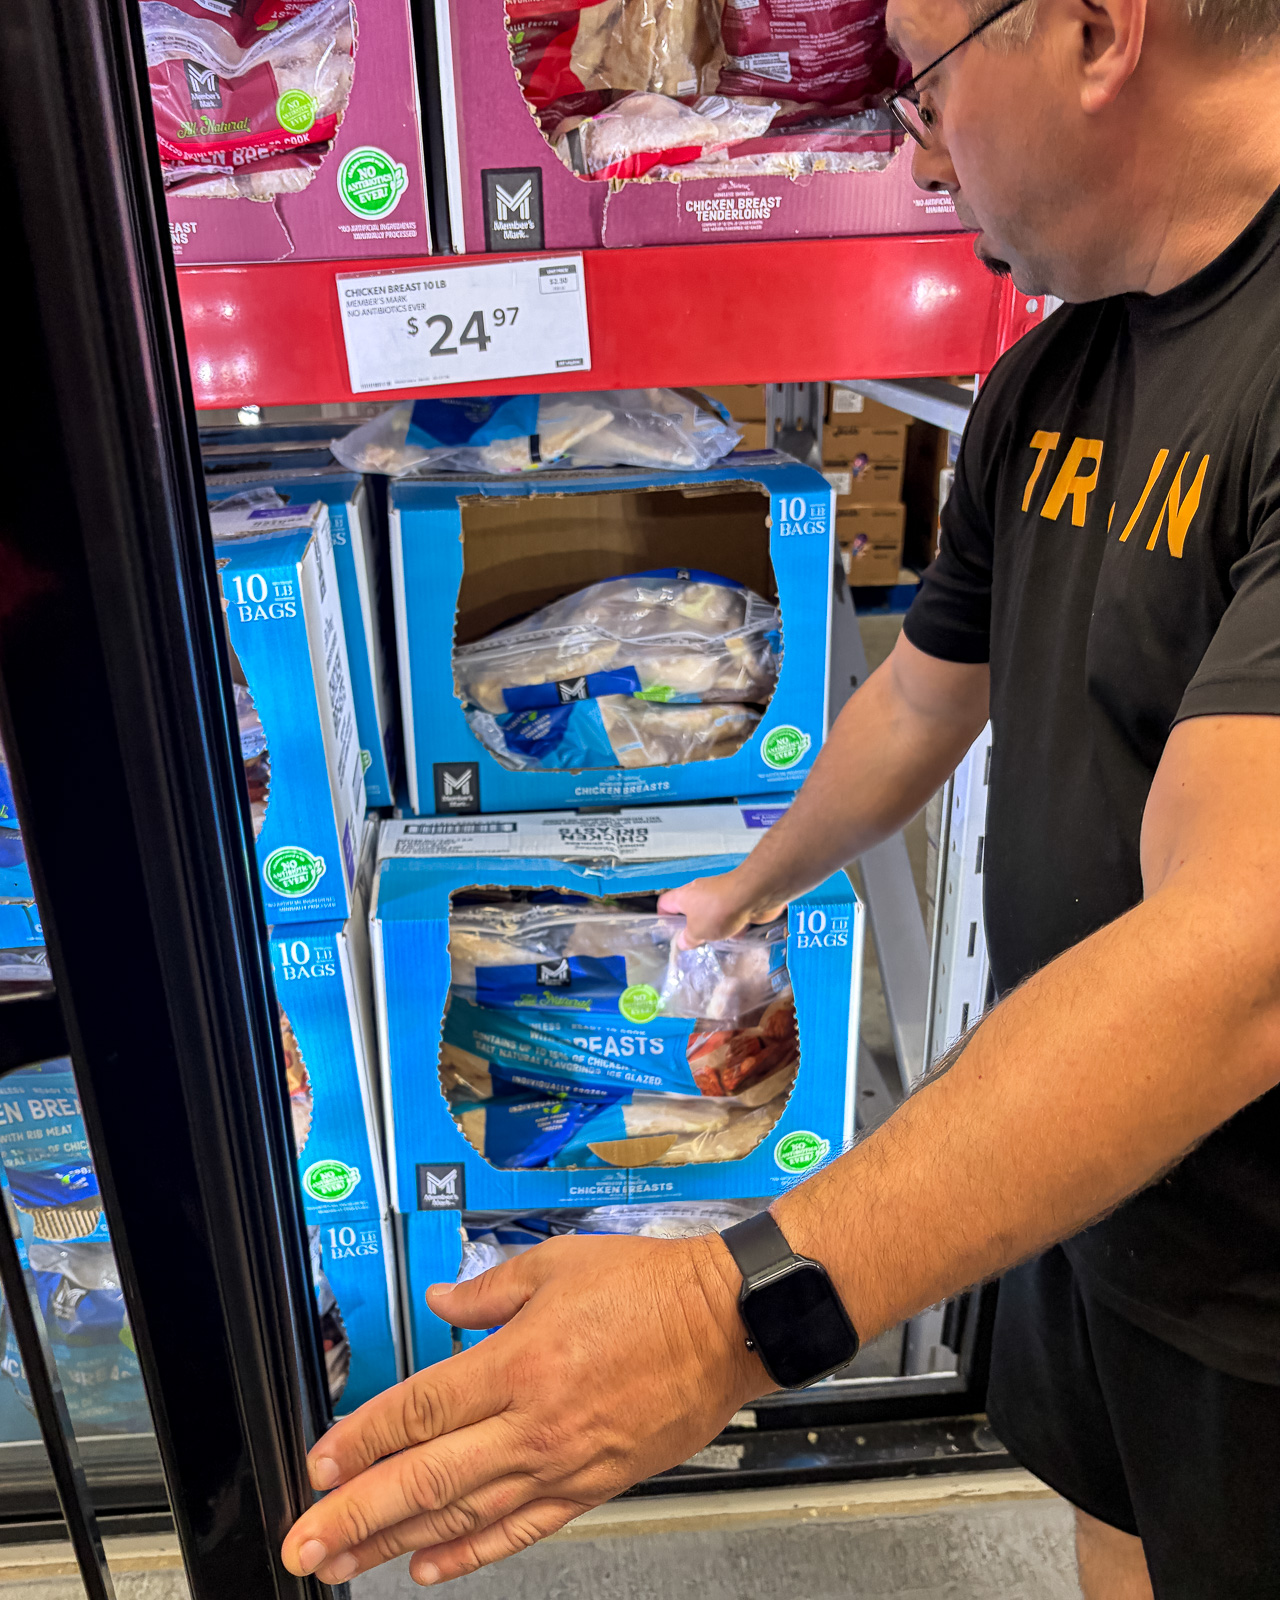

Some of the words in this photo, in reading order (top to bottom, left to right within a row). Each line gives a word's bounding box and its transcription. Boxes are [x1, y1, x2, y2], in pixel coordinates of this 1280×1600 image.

[287, 99, 300, 111] NO
[357, 166, 377, 181] NO
[347, 173, 392, 193] ANTIBIOTICS
[358, 188, 388, 204] EVER!
[685, 198, 735, 212] CHICKEN
[737, 196, 782, 210] BREAST
[696, 207, 771, 222] TENDERLOINS
[493, 220, 535, 231] Member's
[345, 286, 386, 298] CHICKEN
[388, 282, 421, 294] BREAST
[423, 281, 434, 290] 10
[435, 280, 447, 288] LB
[346, 297, 385, 308] MEMBER'S
[386, 295, 408, 304] MARK
[347, 309, 360, 317] NO
[362, 305, 408, 316] ANTIBIOTICS
[408, 303, 427, 312] EVER
[1021, 430, 1210, 559] TRIN
[779, 497, 806, 522] 10
[780, 520, 826, 537] BAGS
[232, 573, 268, 605] 10
[238, 602, 297, 622] BAGS
[776, 737, 789, 746] NO
[574, 786, 621, 796] CHICKEN
[622, 781, 670, 795] BREASTS
[281, 860, 298, 871] NO
[796, 910, 826, 934] 10
[797, 933, 849, 949] BAGS
[278, 940, 310, 966] 10
[283, 963, 336, 980] BAGS
[26, 1129, 44, 1140] RIB
[46, 1124, 73, 1137] MEAT
[320, 1171, 336, 1180] NO
[569, 1185, 621, 1195] CHICKEN
[622, 1182, 674, 1193] BREASTS
[327, 1226, 356, 1249] 10
[330, 1243, 379, 1260] BAGS
